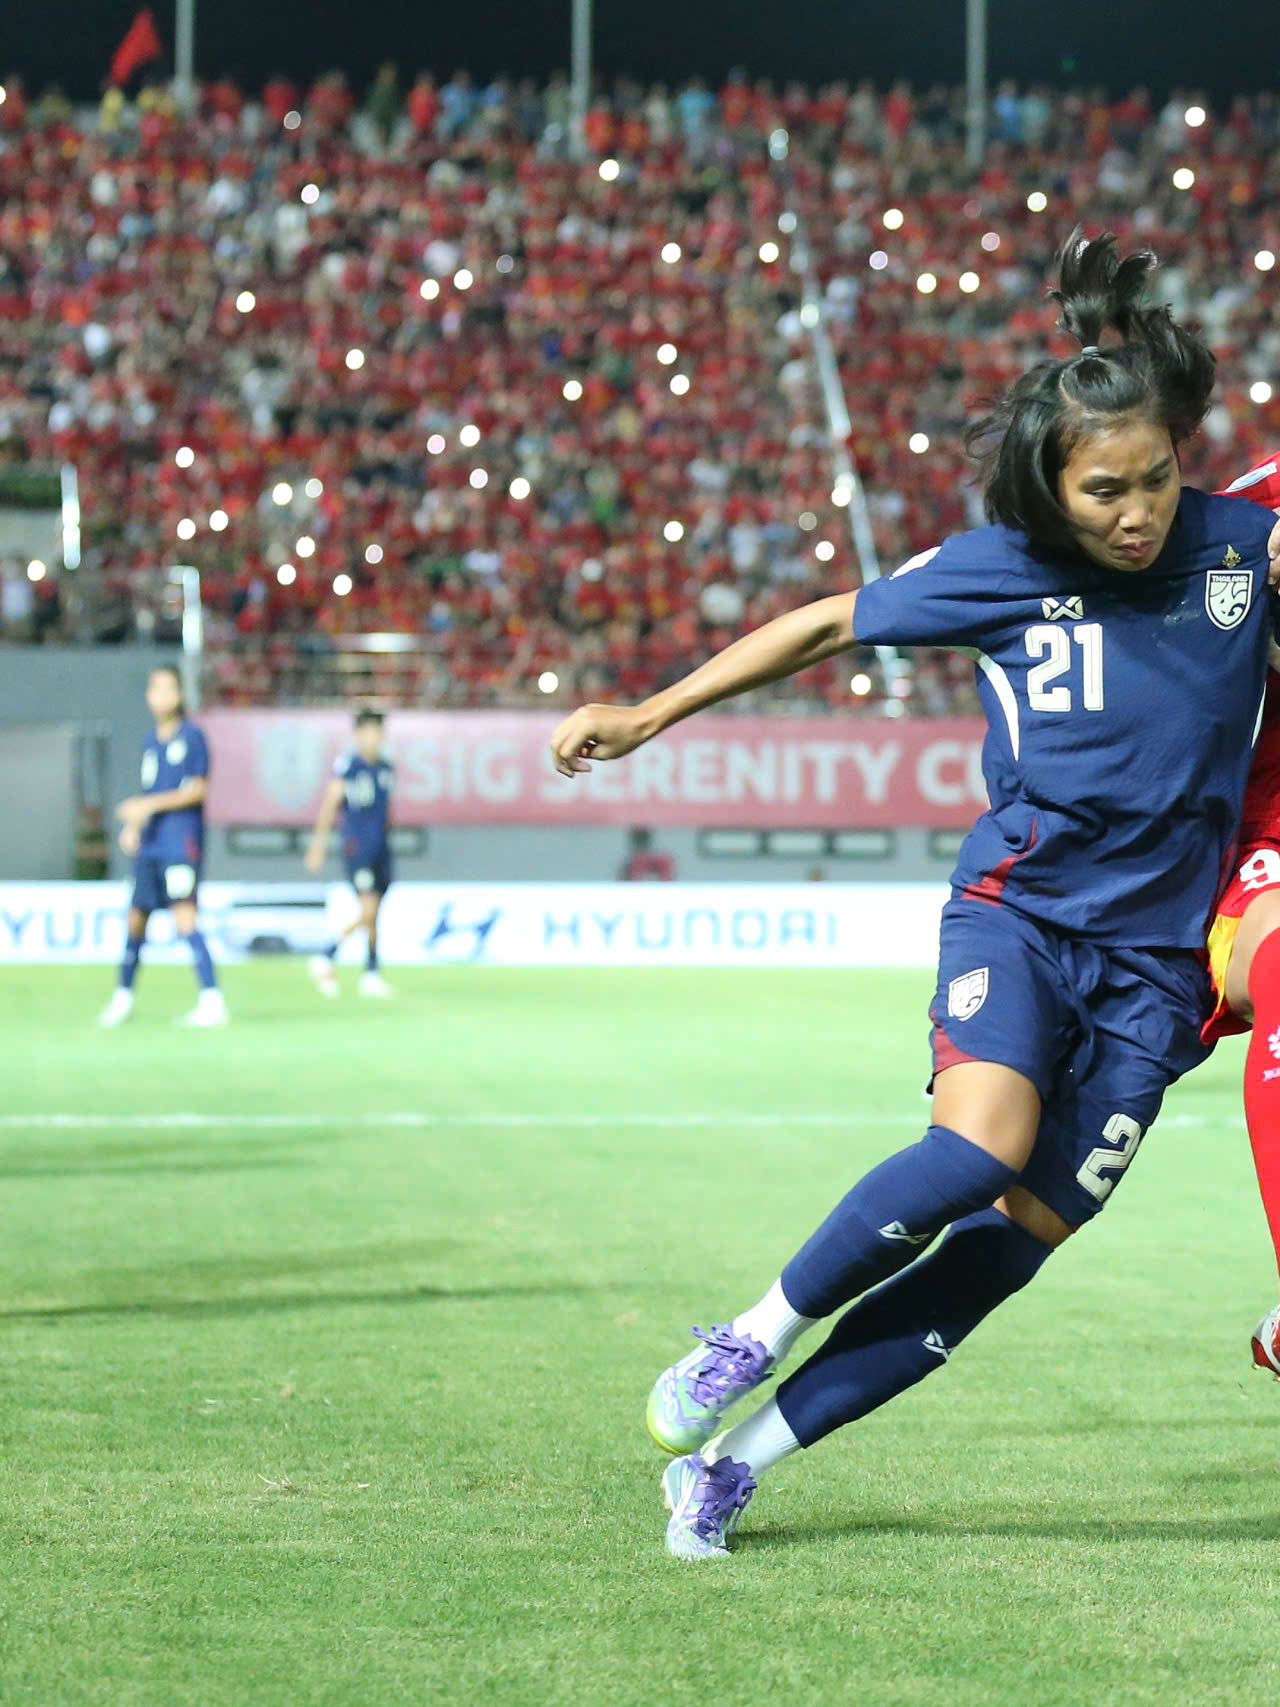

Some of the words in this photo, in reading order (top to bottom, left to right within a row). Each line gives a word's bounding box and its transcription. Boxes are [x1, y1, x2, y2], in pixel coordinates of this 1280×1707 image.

[1211, 575, 1248, 583] THAILAND
[1024, 623, 1104, 712] 21
[542, 906, 839, 951] HYUNDAI
[1076, 1113, 1142, 1202] 2
